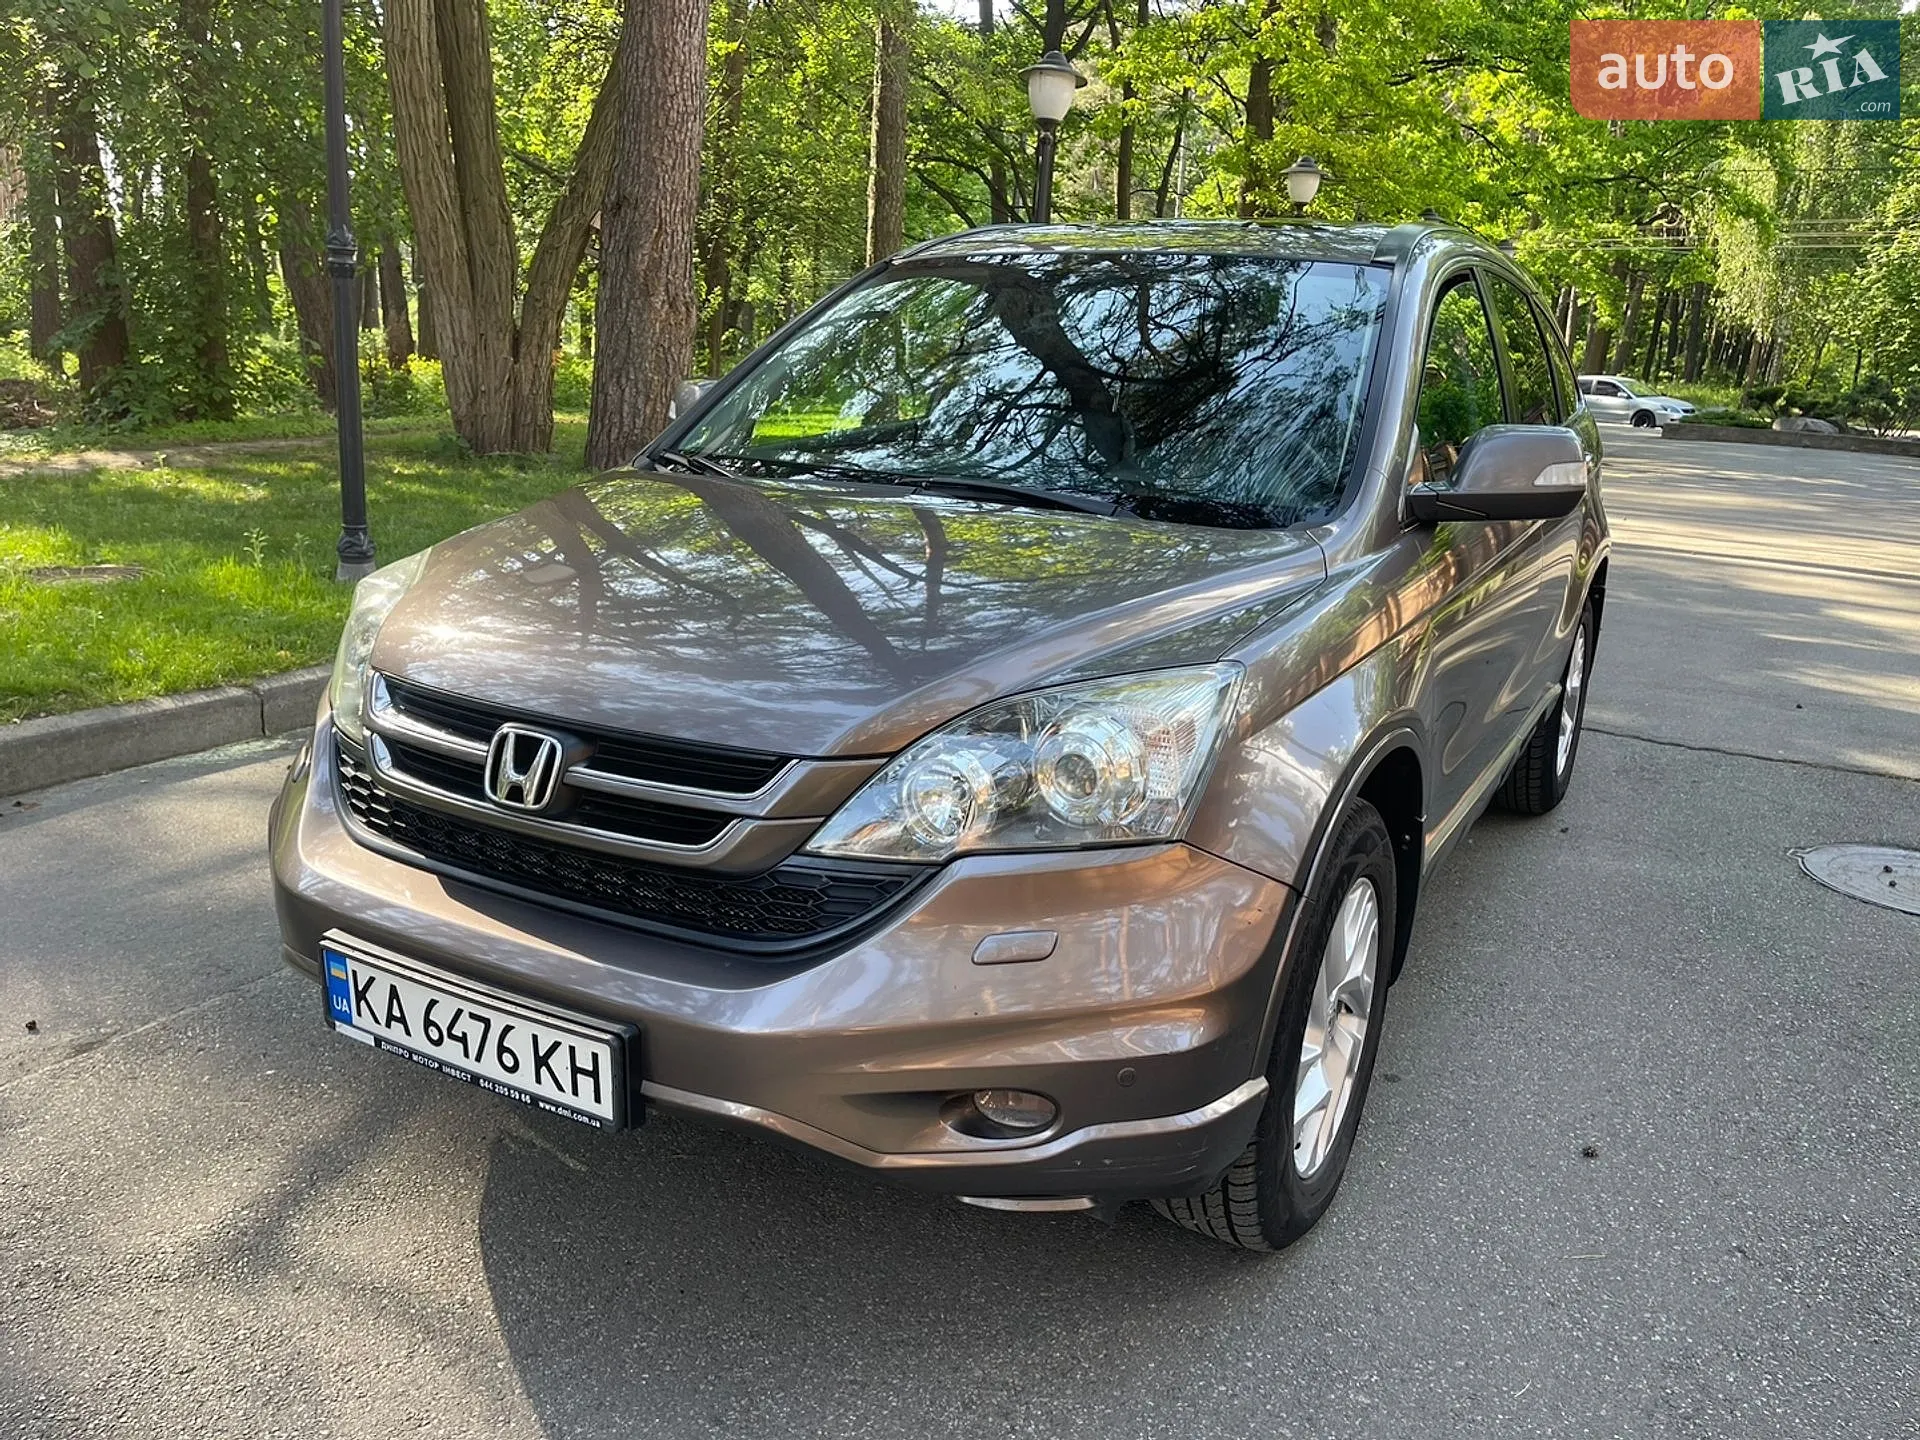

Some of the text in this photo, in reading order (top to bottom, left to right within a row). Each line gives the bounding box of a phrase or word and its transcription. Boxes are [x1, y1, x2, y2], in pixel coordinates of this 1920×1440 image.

[333, 994, 350, 1015] UA
[352, 969, 602, 1104] KA 6476 KH
